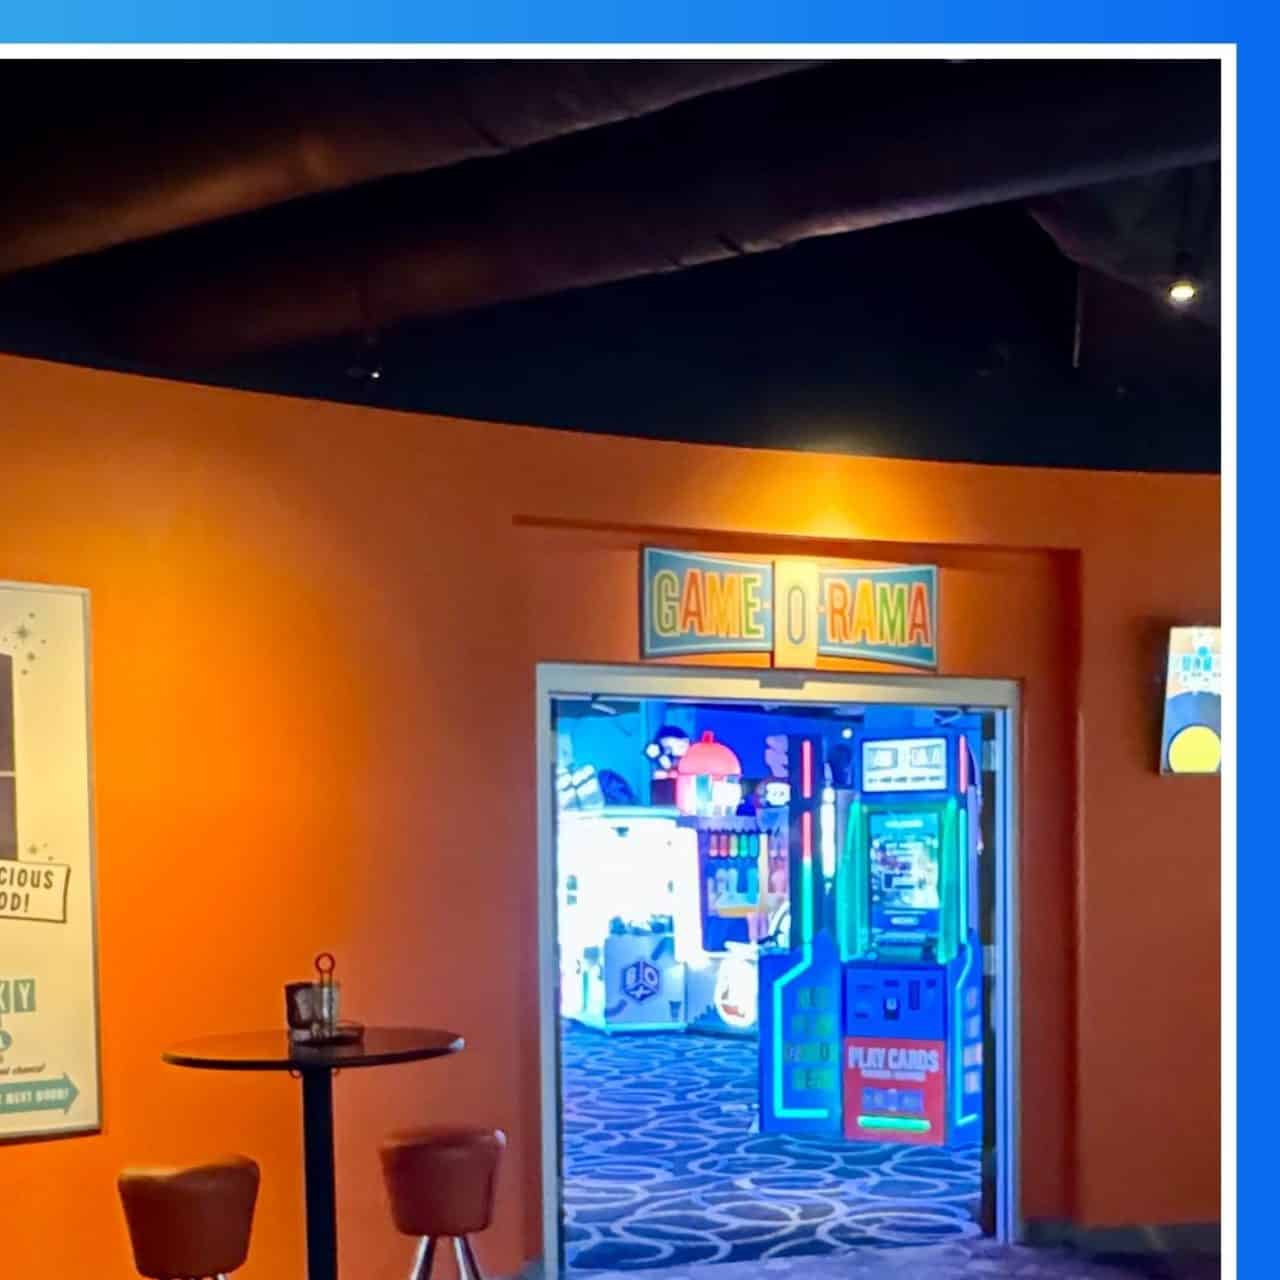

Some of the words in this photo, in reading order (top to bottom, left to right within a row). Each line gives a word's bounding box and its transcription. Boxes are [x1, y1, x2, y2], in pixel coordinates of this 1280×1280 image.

[847, 1045, 886, 1070] PLAY
[887, 1046, 940, 1073] CARDS
[4, 1090, 33, 1105] NEXT
